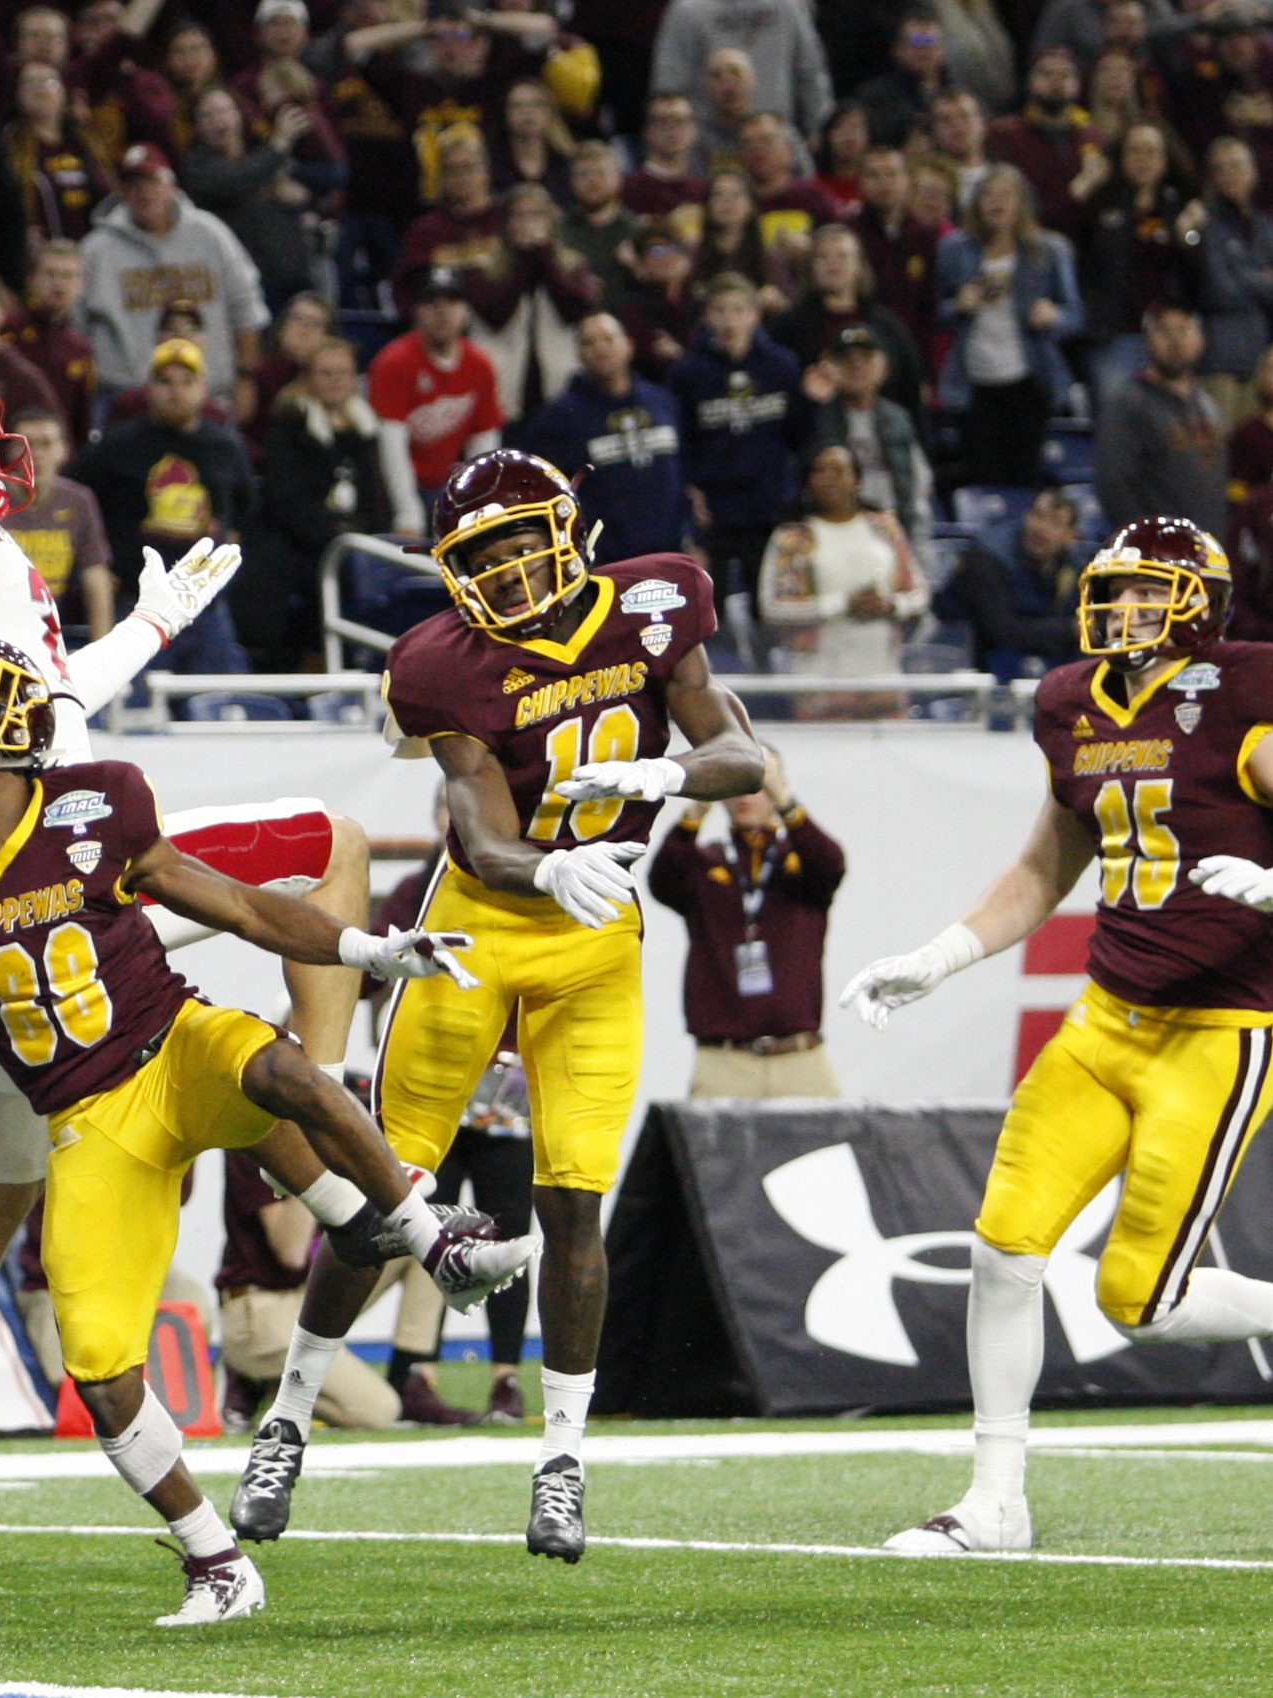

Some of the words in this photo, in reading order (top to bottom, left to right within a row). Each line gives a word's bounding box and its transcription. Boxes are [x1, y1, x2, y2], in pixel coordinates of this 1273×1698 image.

[637, 588, 673, 603] MAC
[502, 674, 536, 694] adidas
[514, 661, 649, 730] CHIPPEWAS
[1073, 739, 1174, 776] CHIPPEWAS
[60, 796, 101, 815] MAC
